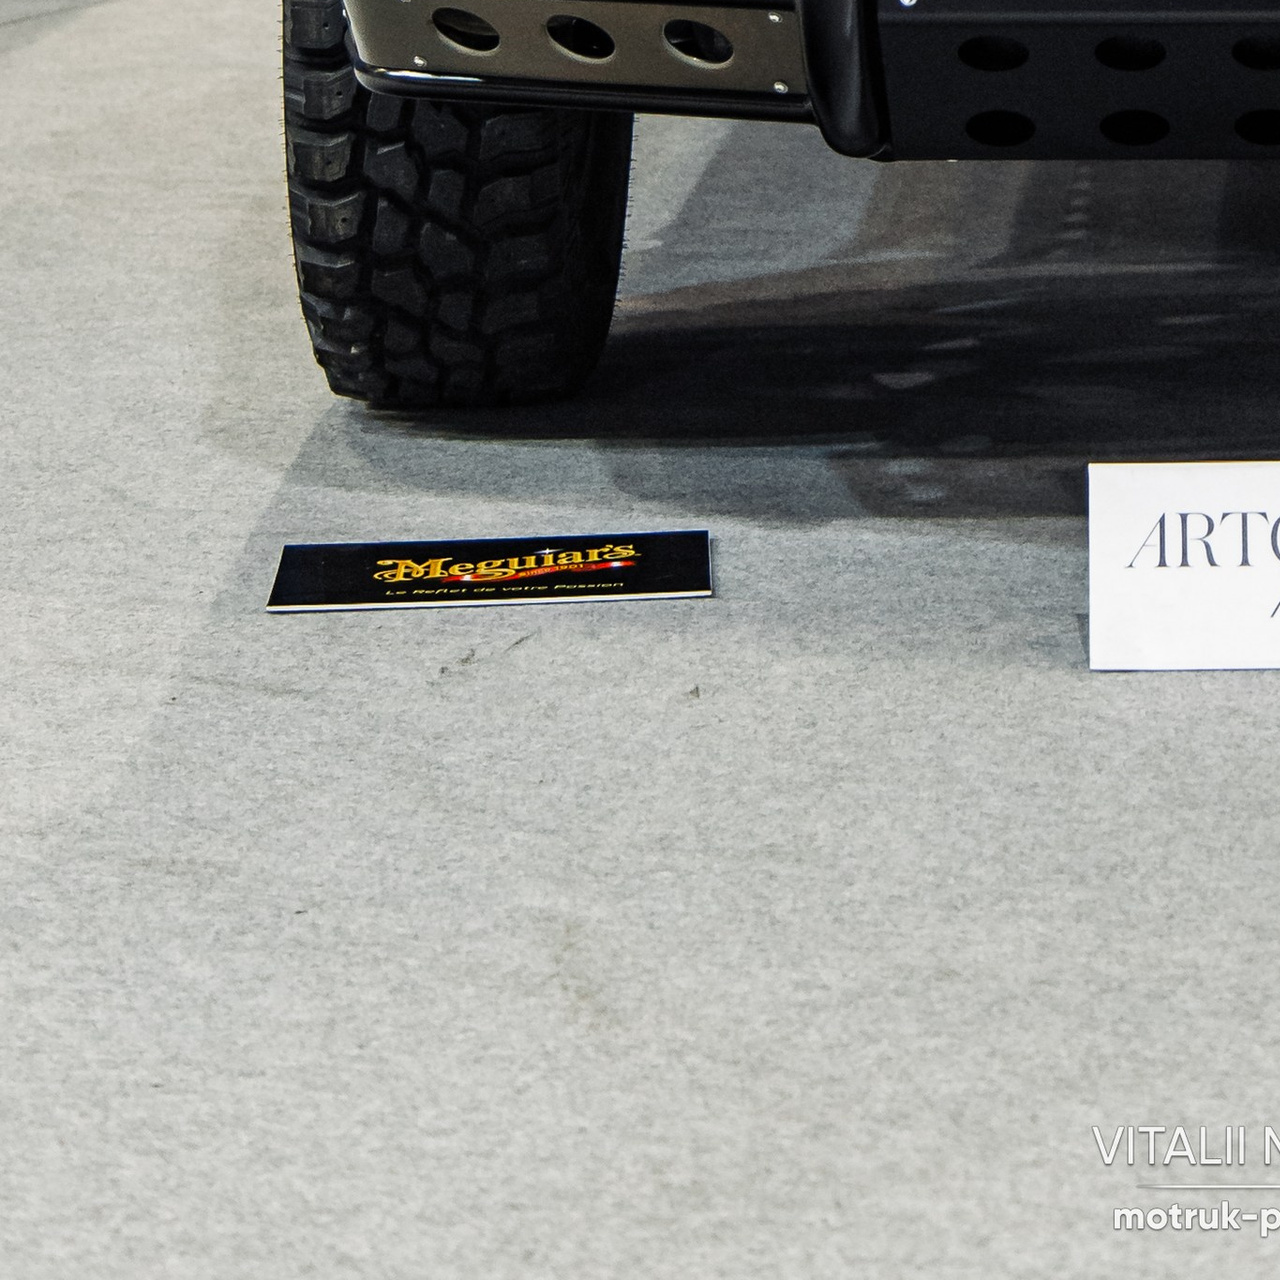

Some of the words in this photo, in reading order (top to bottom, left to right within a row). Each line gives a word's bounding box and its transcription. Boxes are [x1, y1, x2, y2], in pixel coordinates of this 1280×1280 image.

[373, 543, 636, 582] Meguiar's
[554, 563, 585, 571] 1901
[412, 586, 467, 595] Reflet
[473, 585, 497, 593] de
[502, 583, 549, 591] votre
[554, 581, 624, 590] Passion
